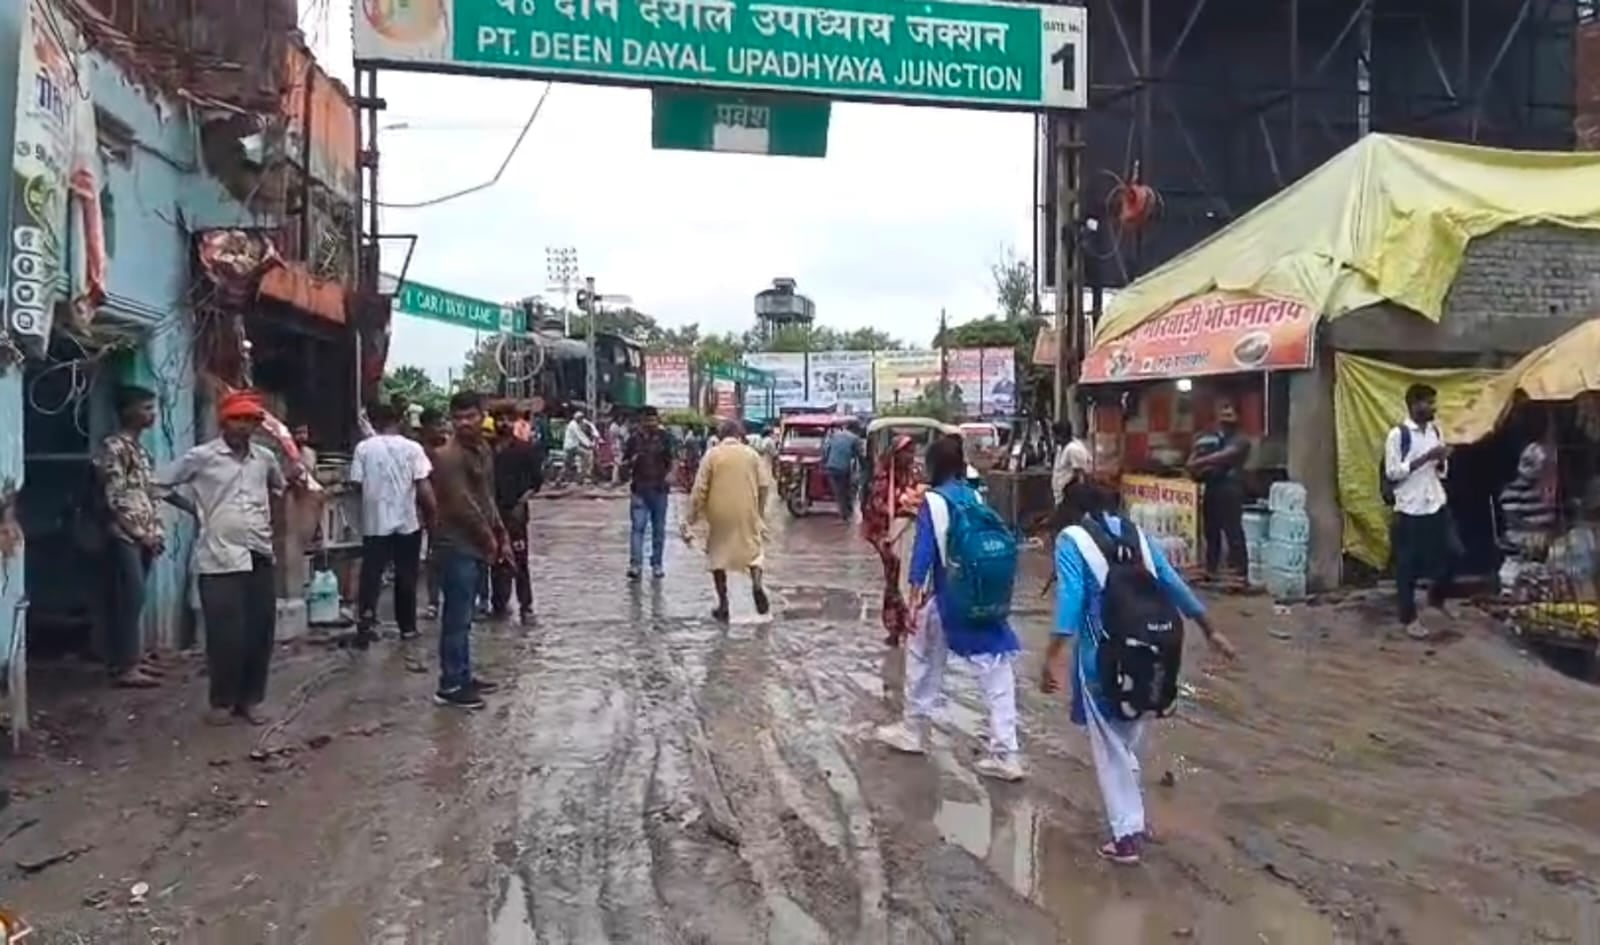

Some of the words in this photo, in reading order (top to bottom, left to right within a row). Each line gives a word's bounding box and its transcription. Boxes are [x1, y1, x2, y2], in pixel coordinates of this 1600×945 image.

[748, 4, 895, 46] उपाध्याय
[905, 4, 1010, 53] जंक्शन
[477, 26, 520, 56] PT.
[530, 31, 613, 64] DEEN
[623, 38, 717, 72] DAYAL
[727, 46, 887, 85] UPADHYAYA
[894, 59, 1023, 93] JUNCTION
[1051, 42, 1076, 92] 1
